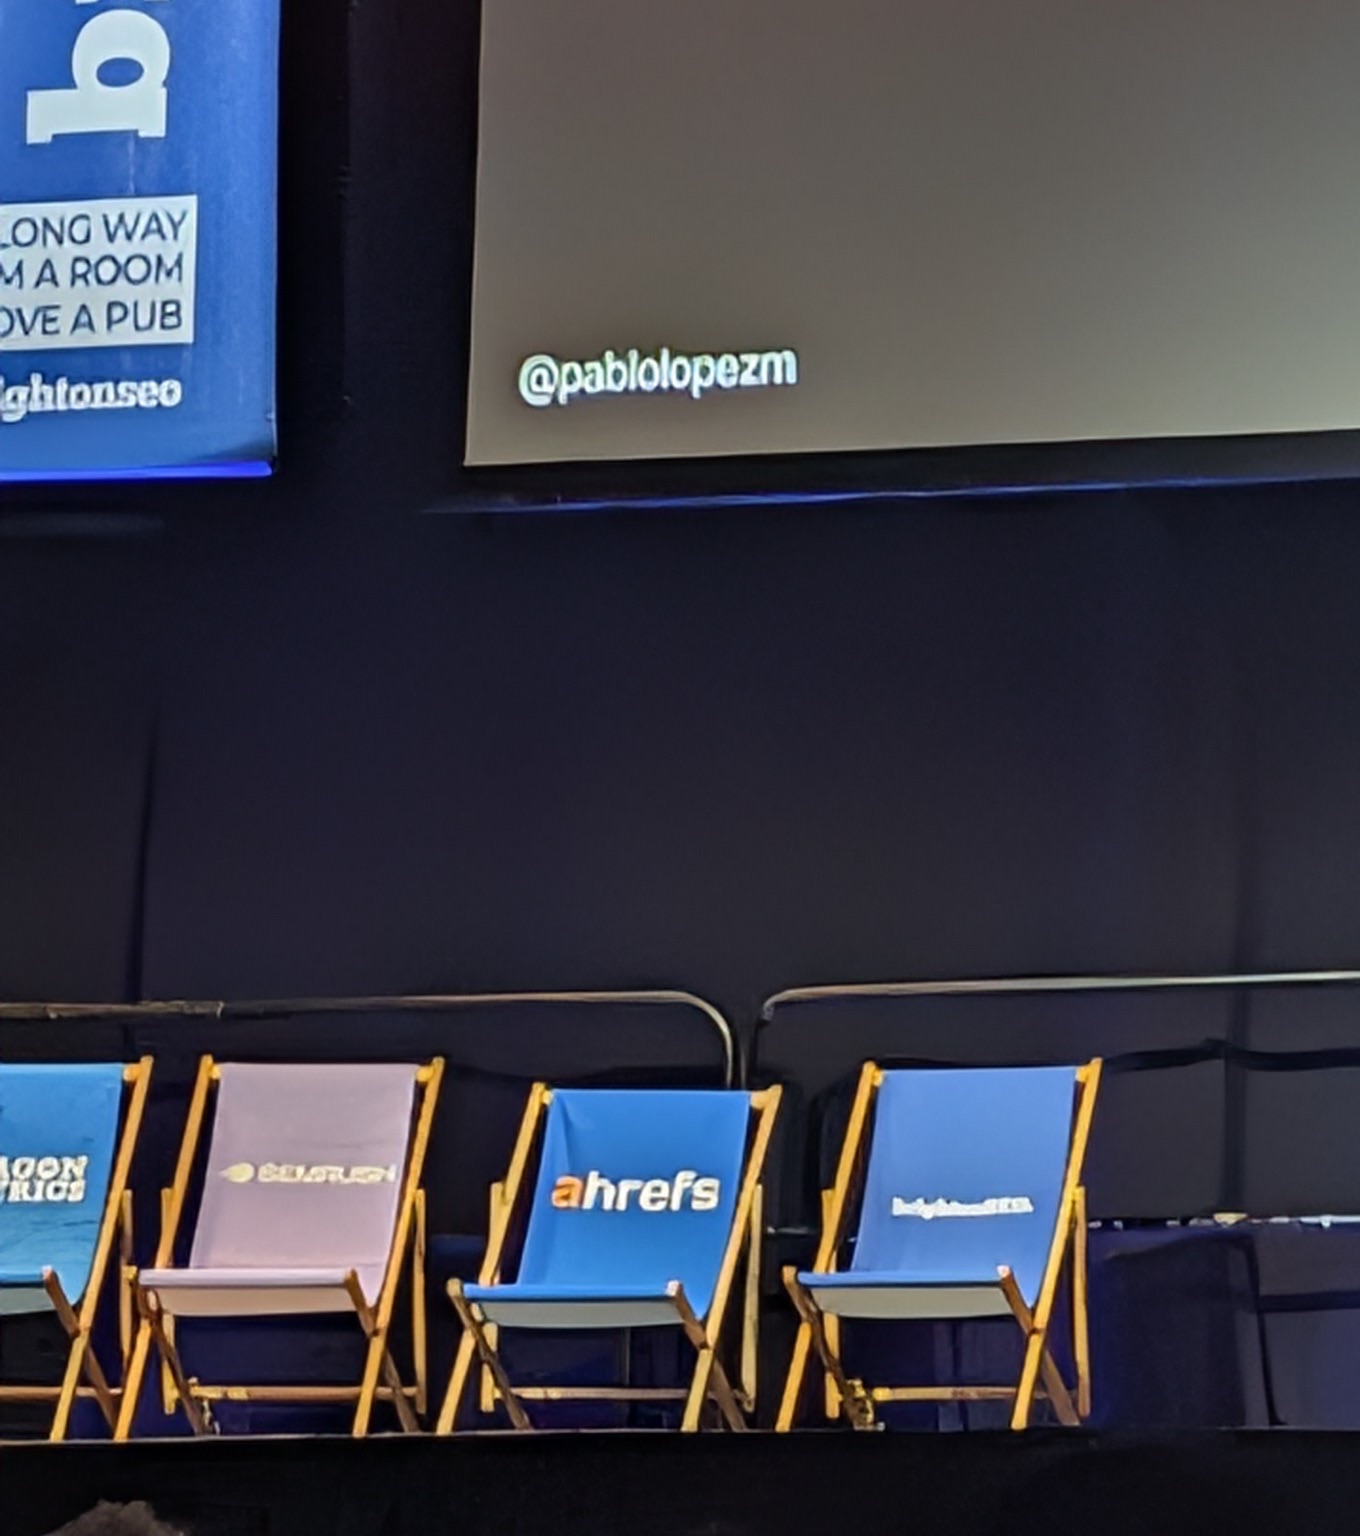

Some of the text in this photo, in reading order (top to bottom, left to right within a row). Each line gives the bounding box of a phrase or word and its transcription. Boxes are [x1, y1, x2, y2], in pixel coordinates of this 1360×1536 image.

[102, 209, 188, 244] WAY
[34, 258, 60, 289] A
[70, 252, 184, 287] ROOM
[70, 303, 96, 335] A
[106, 299, 183, 333] PUB
[518, 348, 799, 407] @pablolopezm
[551, 1170, 721, 1212] ahrefs
